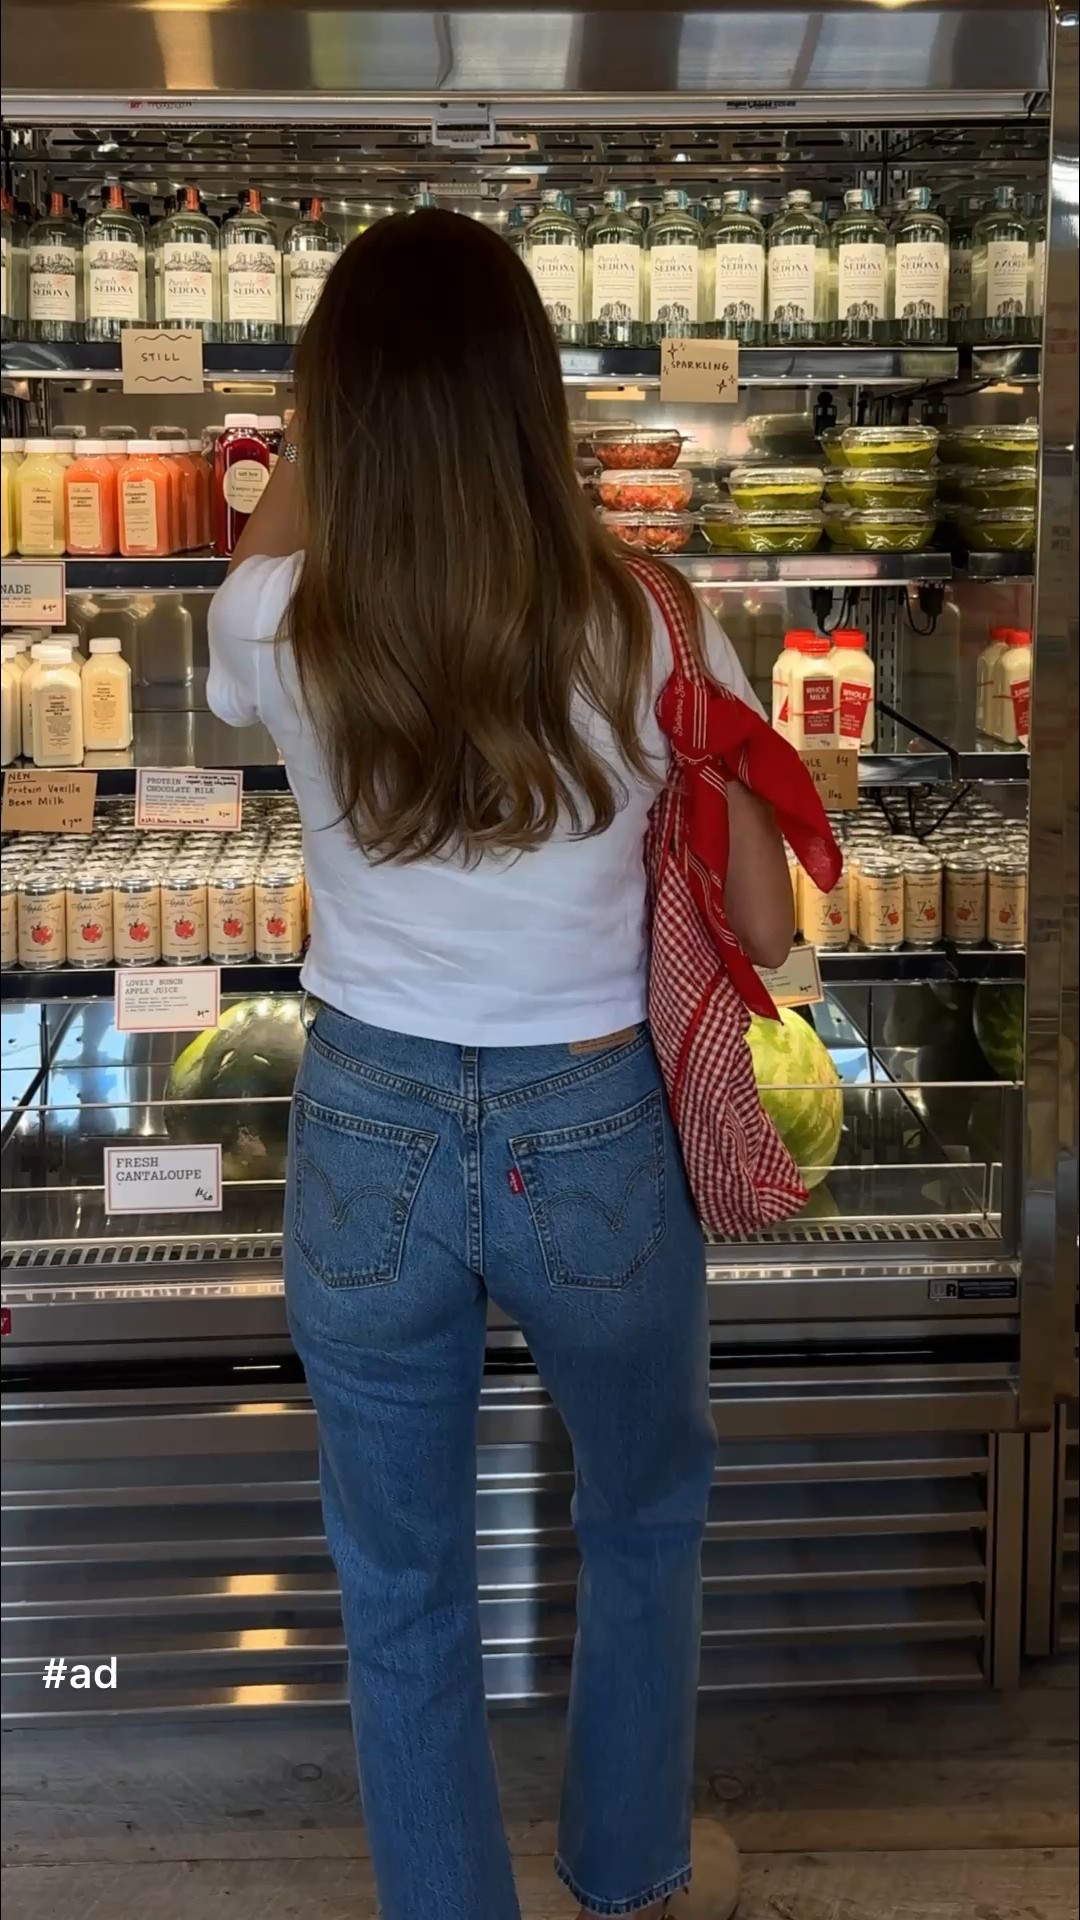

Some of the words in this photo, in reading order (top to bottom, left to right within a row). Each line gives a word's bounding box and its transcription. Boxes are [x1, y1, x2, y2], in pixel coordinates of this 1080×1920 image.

[536, 264, 574, 272] SEDONA
[597, 263, 635, 272] SEDONA
[655, 264, 693, 273] SEDONA
[721, 263, 758, 272] SEDONA
[772, 265, 808, 273] SEDONA
[844, 262, 881, 271] SEDONA
[900, 262, 939, 270] SEDONA
[33, 288, 70, 297] SEDONA
[94, 285, 133, 294] SEDONA
[168, 286, 206, 295] SEDONA
[233, 287, 272, 296] SEDONA
[141, 352, 180, 362] STILL
[671, 360, 729, 371] SPARKLING
[843, 689, 867, 700] WHOLE
[8, 772, 31, 781] NEW
[147, 777, 181, 785] PROTEIN
[7, 785, 41, 794] Protein
[48, 783, 81, 794] Vanilla
[146, 785, 190, 794] CHOCOLATE
[9, 799, 32, 807] Bean
[38, 797, 64, 806] Milk
[125, 979, 154, 987] LOVELY
[125, 987, 149, 995] APPLE
[116, 1157, 159, 1168] FRESH
[116, 1169, 202, 1182] CANTALOUPE
